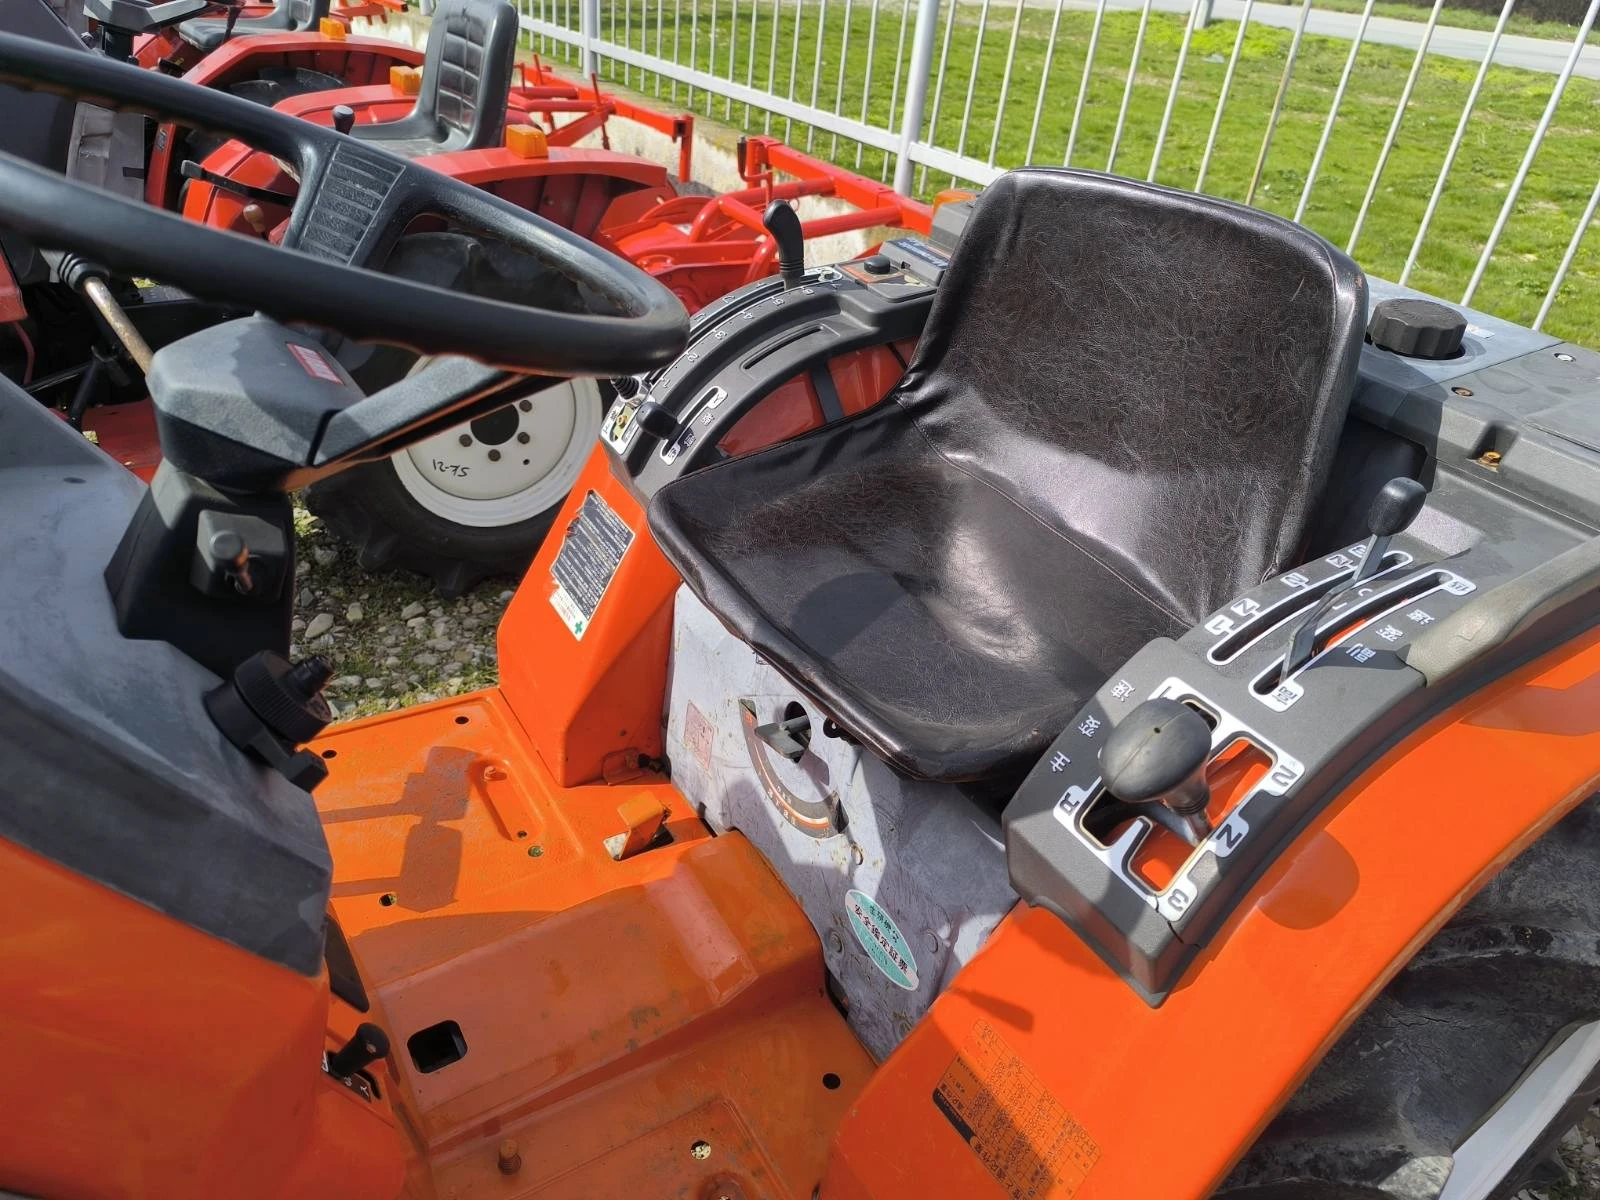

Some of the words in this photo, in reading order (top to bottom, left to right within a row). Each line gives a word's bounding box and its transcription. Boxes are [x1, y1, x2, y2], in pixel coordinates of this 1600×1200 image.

[687, 352, 699, 362] 2
[715, 330, 727, 340] 3
[1235, 601, 1254, 615] N
[1329, 555, 1347, 567] N
[1346, 609, 1435, 663] 副変速
[1051, 680, 1136, 772] 主変速
[1271, 765, 1298, 787] 2
[1058, 793, 1081, 816] R
[1216, 823, 1243, 849] N
[1167, 888, 1189, 912] 3
